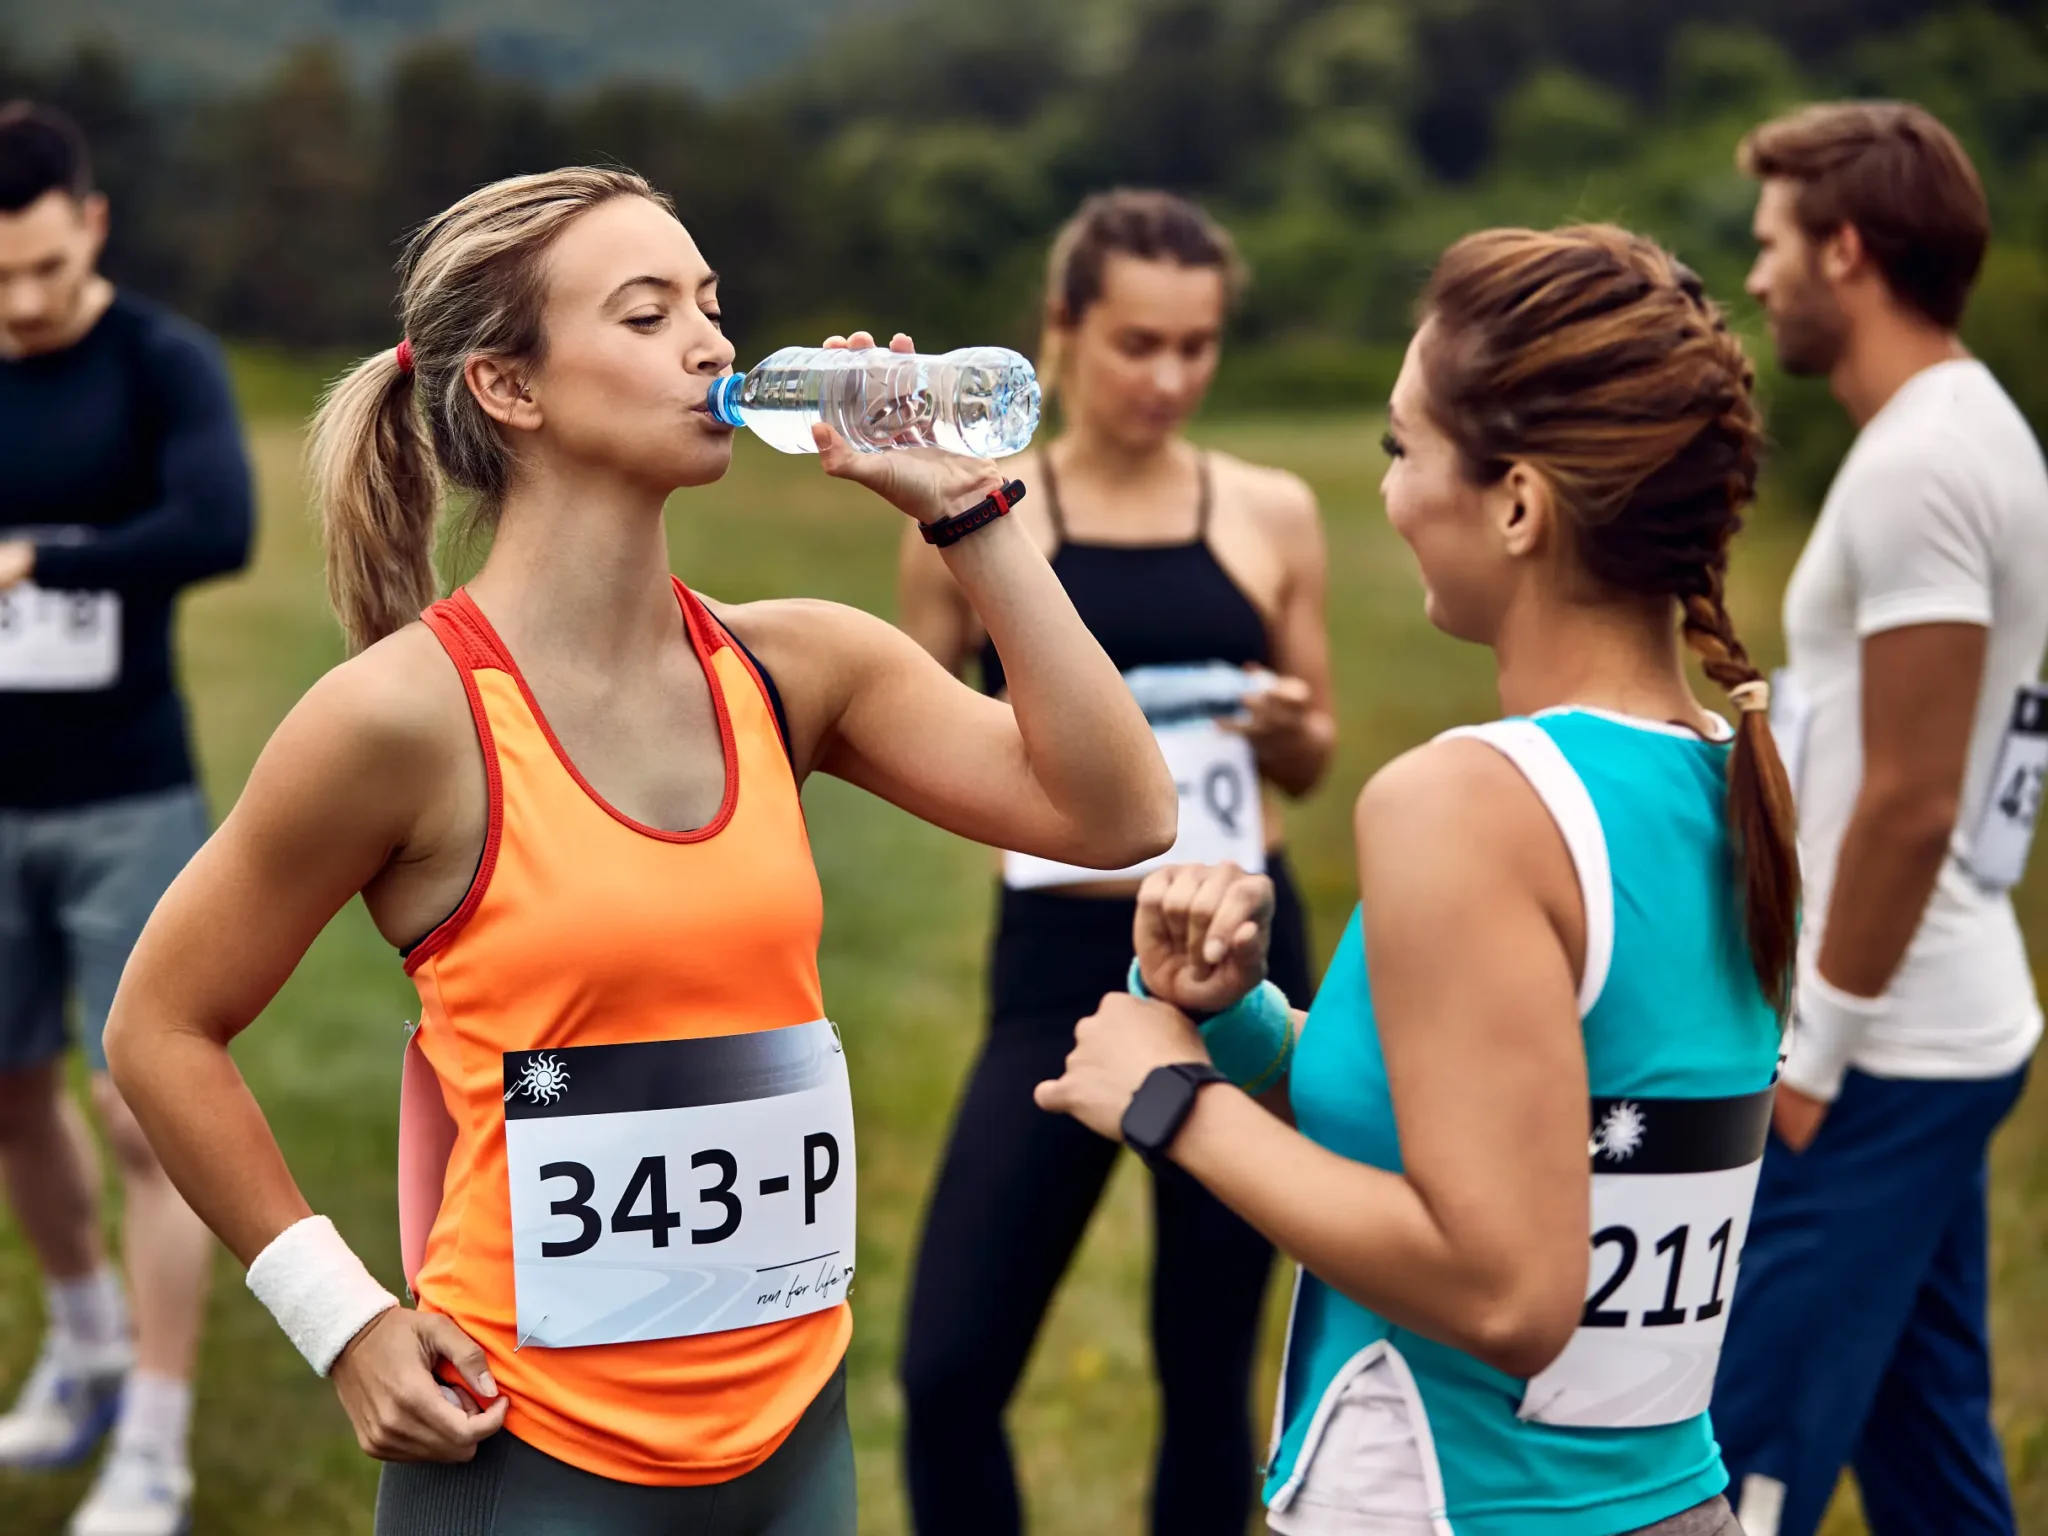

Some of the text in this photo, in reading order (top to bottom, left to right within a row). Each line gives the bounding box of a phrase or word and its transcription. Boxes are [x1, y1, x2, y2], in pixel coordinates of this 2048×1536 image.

[538, 1131, 841, 1258] 343-P
[757, 1260, 840, 1309] run for life
